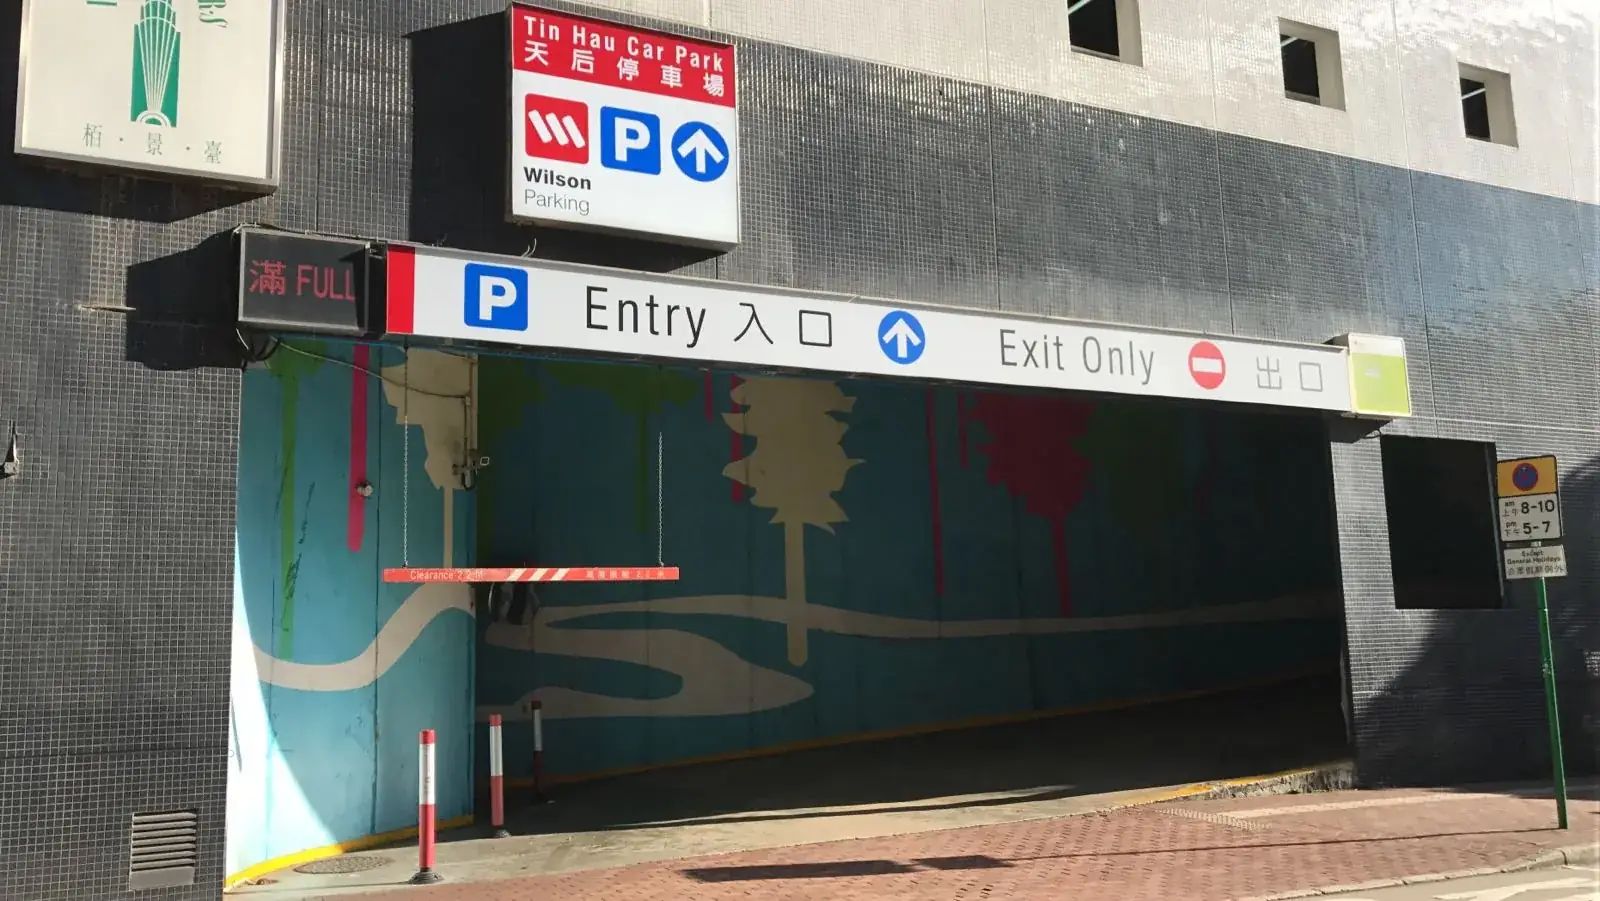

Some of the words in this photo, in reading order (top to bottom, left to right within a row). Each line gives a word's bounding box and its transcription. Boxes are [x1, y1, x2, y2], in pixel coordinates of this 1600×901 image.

[523, 15, 560, 41] Tin
[572, 25, 615, 52] Hau
[626, 36, 664, 61] Car
[675, 45, 723, 73] Park
[524, 40, 725, 97] 天后停車場
[614, 116, 651, 163] P
[523, 166, 592, 191] Wilson
[524, 189, 590, 217] Parking
[297, 264, 357, 302] FULL
[479, 275, 517, 321] P
[586, 285, 706, 349] Entry
[733, 302, 833, 348] 入口
[1000, 329, 1064, 371] Exit
[1082, 335, 1155, 385] Only
[1256, 355, 1324, 393] 出口
[1521, 500, 1555, 514] 8-10
[1522, 521, 1551, 534] 5-7
[410, 569, 454, 581] Clearance
[1532, 555, 1562, 563] Holidays
